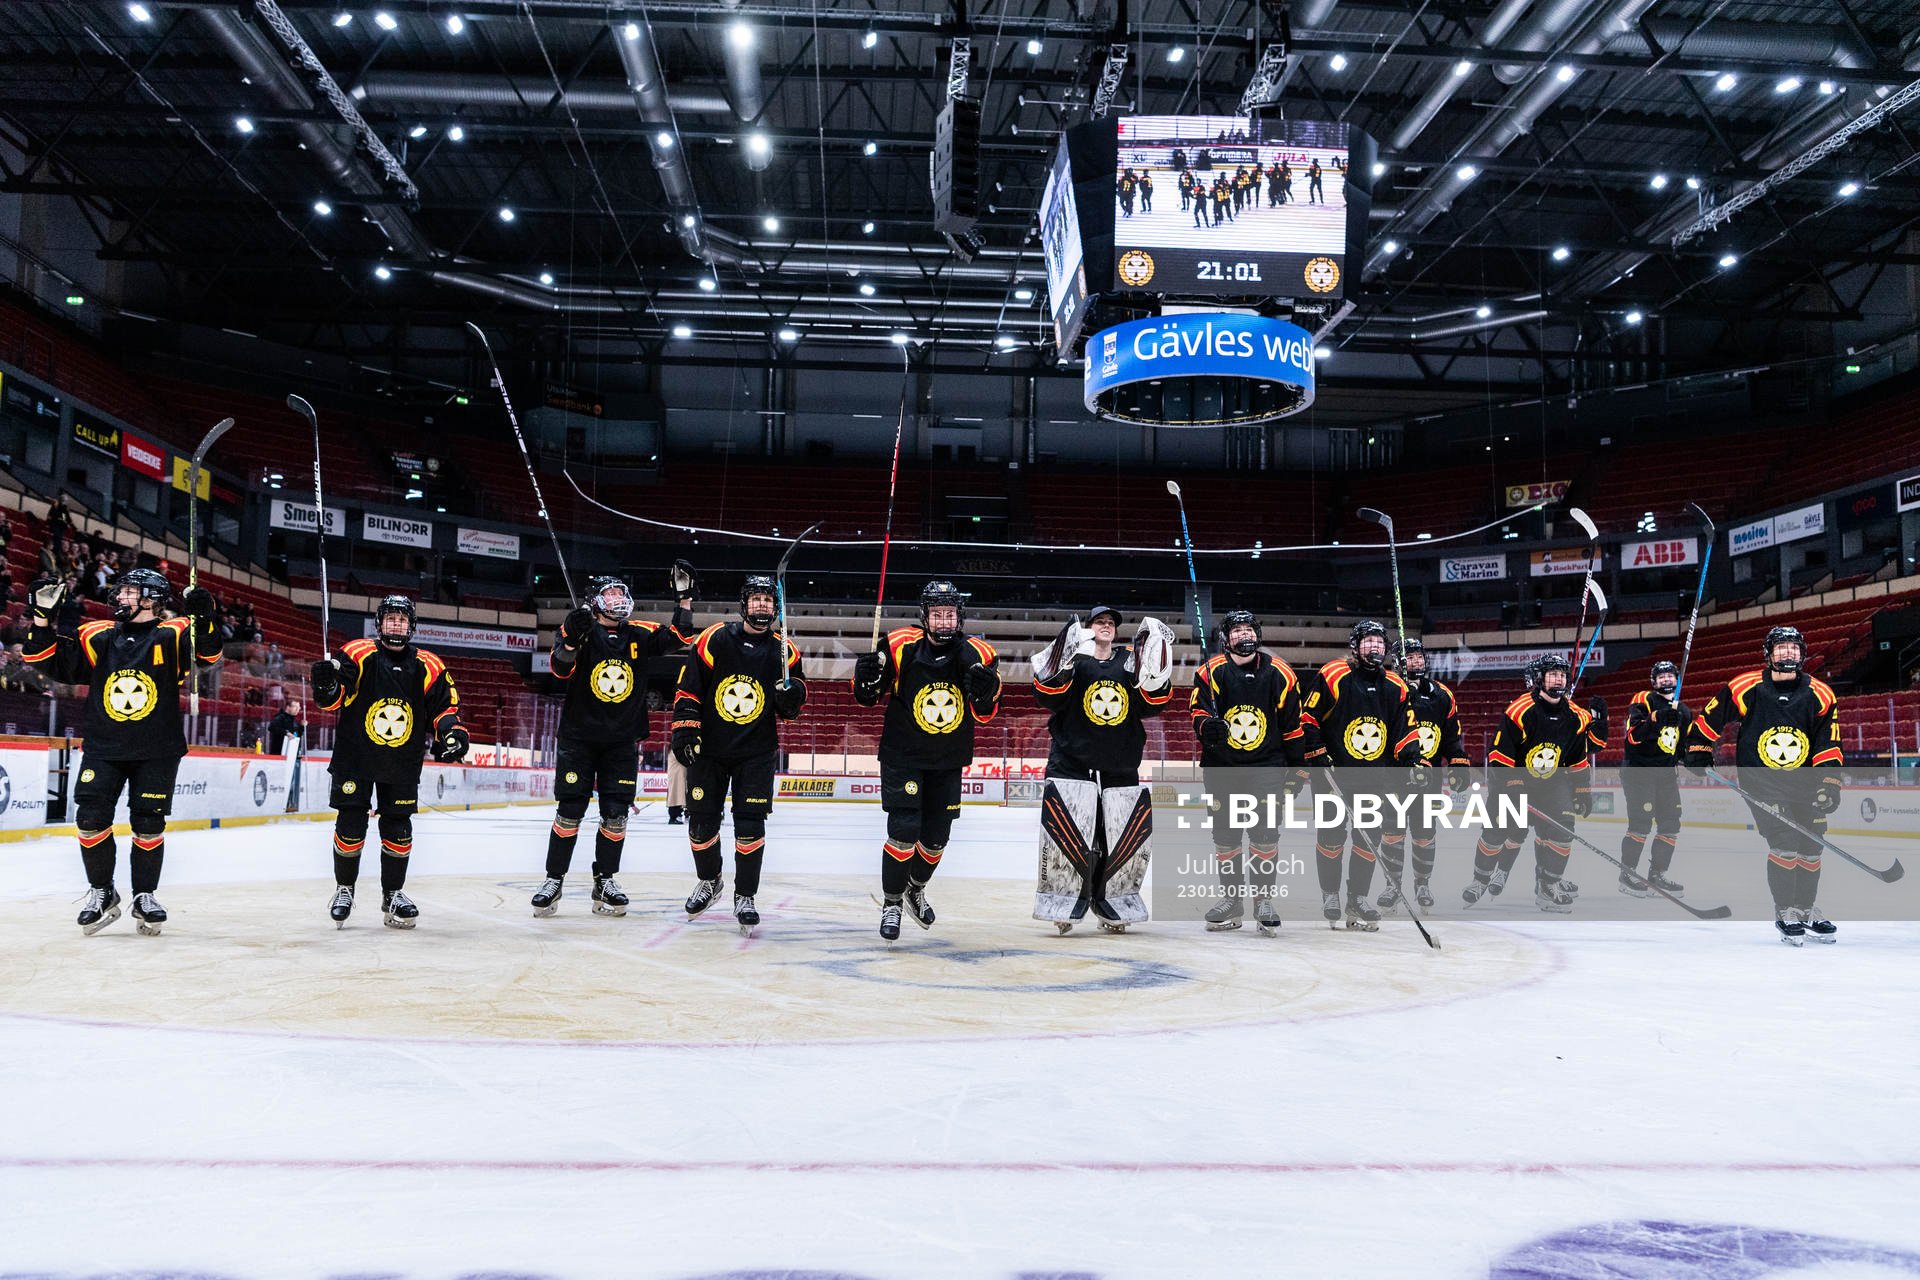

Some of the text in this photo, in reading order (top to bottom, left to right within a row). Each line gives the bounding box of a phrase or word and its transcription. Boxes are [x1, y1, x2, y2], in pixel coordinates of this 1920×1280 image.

[1274, 153, 1307, 162] JULA
[1197, 261, 1262, 282] 21:01
[1134, 322, 1254, 360] Gävles
[75, 424, 110, 446] CALL UP
[367, 516, 429, 537] BILINORR
[391, 533, 415, 543] TOYOTA
[1733, 525, 1769, 545] monitor
[1633, 541, 1686, 566] ABB
[1453, 561, 1499, 571] Caravan
[1460, 570, 1499, 580] Marine
[418, 627, 448, 638] veckans
[449, 630, 463, 639] mat
[153, 644, 164, 666] A
[629, 641, 638, 660] C
[118, 669, 136, 677] 1912
[737, 674, 753, 683] 1912
[931, 682, 949, 690] 1912
[387, 697, 403, 705] 1912
[1239, 704, 1255, 713] 1912
[1363, 716, 1378, 724] 1912
[172, 780, 208, 796] aniet
[781, 778, 834, 792] BLÅKLÄDER
[11, 800, 46, 810] FACILITY
